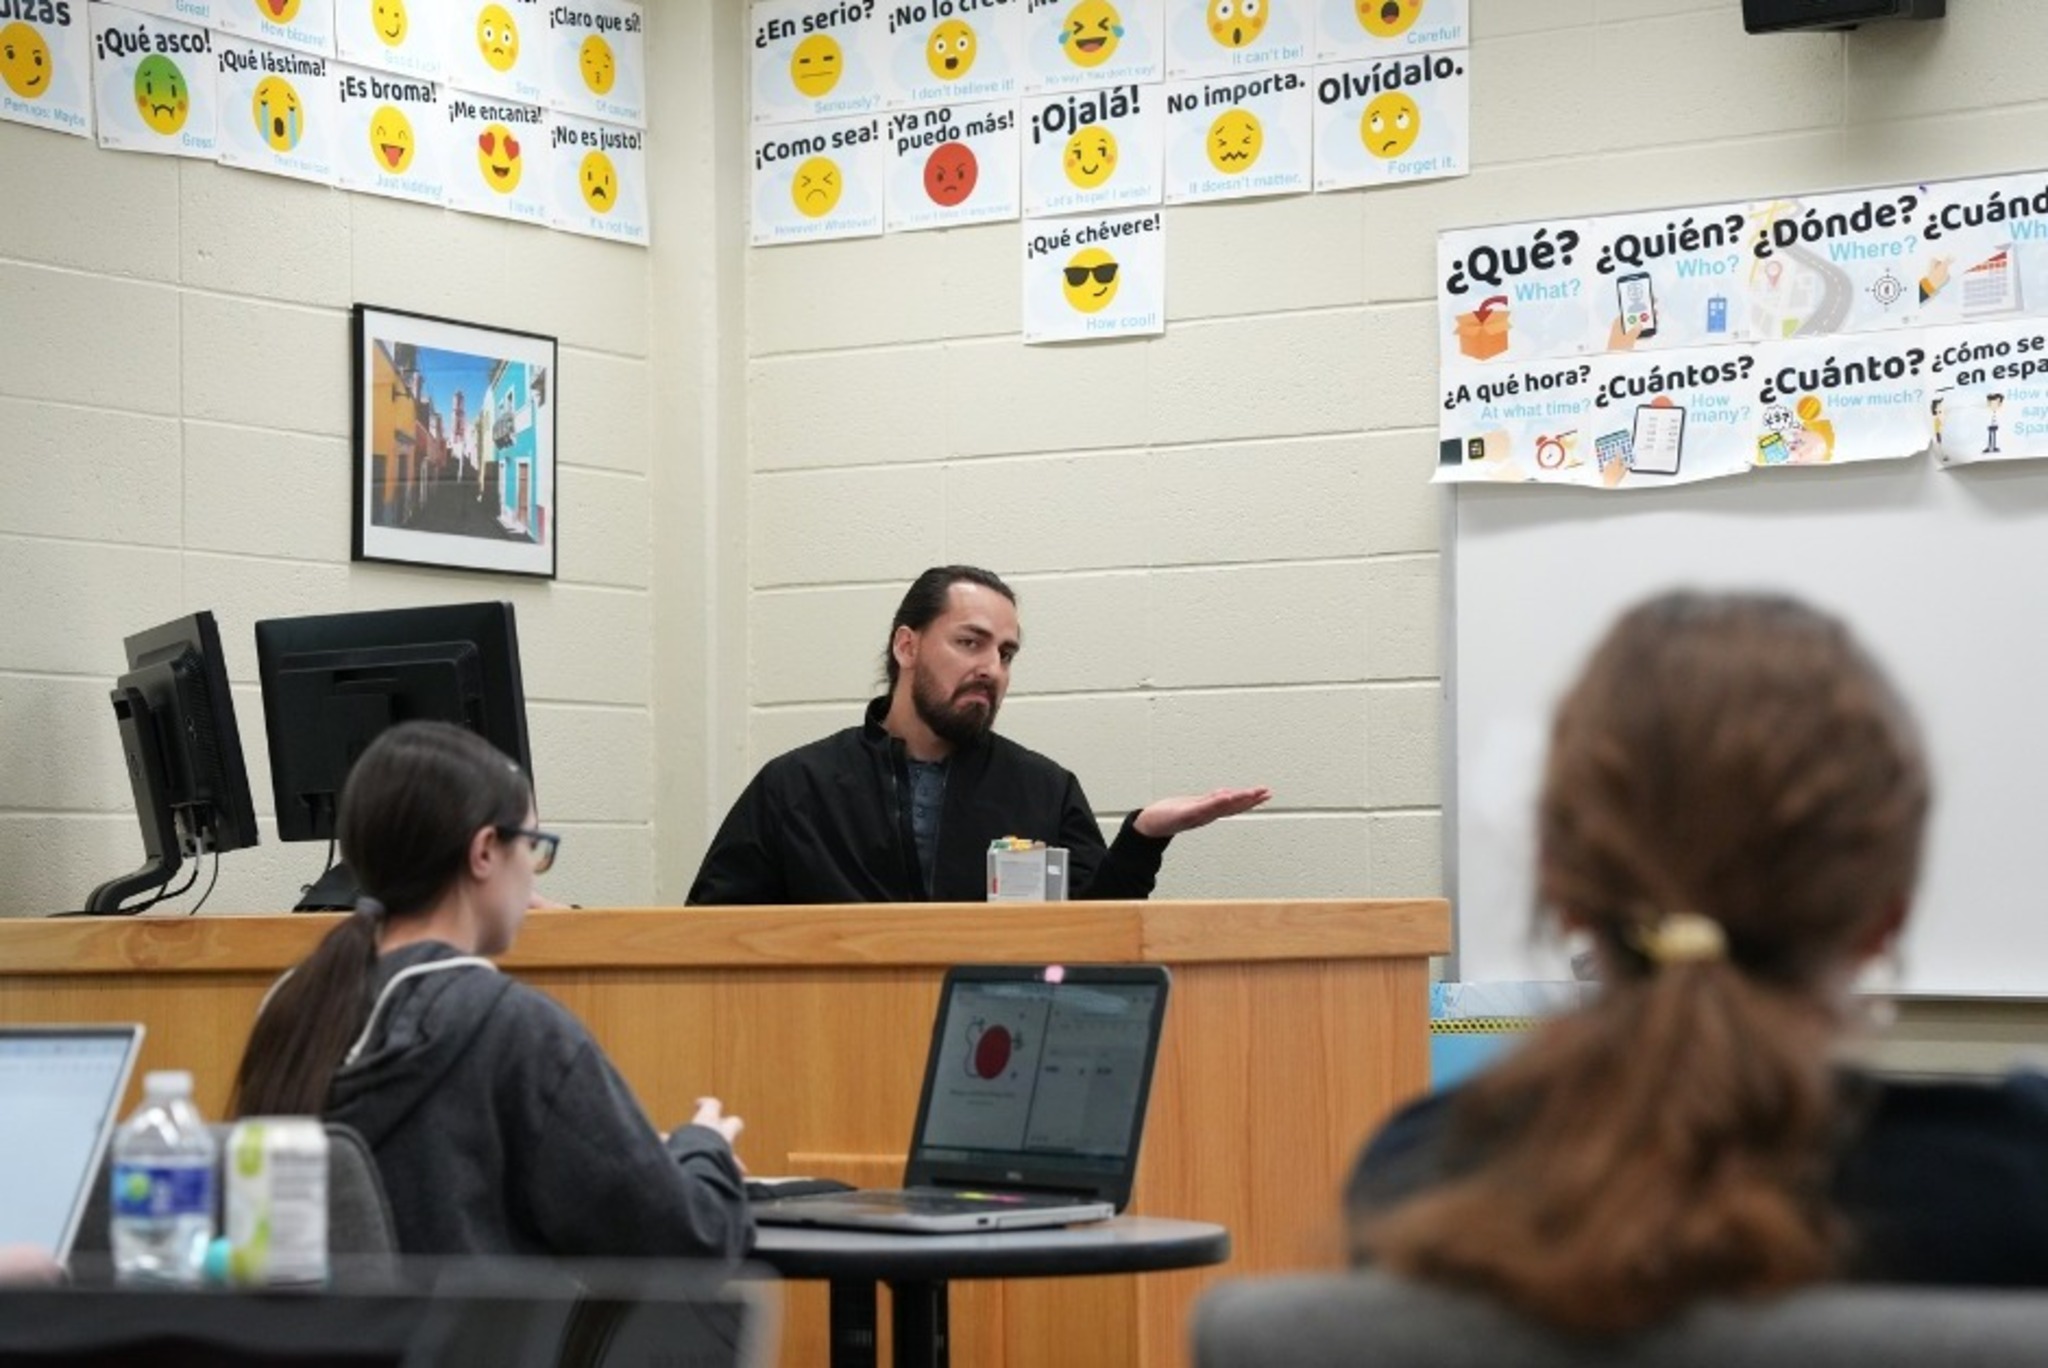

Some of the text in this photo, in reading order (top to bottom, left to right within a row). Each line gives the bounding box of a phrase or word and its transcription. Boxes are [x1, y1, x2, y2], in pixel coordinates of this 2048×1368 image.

[550, 5, 593, 29] ¡Claro
[595, 14, 622, 33] que
[755, 0, 875, 48] ¿En serio?
[888, 5, 926, 34] ¡No
[932, 0, 953, 18] lo
[96, 24, 212, 60] ¡Qué asco!
[1407, 27, 1461, 45] Careful!
[218, 49, 326, 77] ¡Qué lástima!
[340, 76, 437, 103] ¡Es broma!
[918, 84, 951, 99] don't
[953, 81, 999, 96] believe
[1167, 72, 1305, 114] No importa.
[1318, 54, 1463, 104] Olvídalo.
[449, 101, 543, 124] ¡Me encanta!
[814, 95, 881, 114] Seriously?
[1032, 84, 1140, 144] ¡Ojalá!
[551, 126, 641, 150] ¡No es justo!
[887, 108, 952, 140] ¡Ya no
[897, 110, 1015, 156] puedo más!
[755, 120, 879, 170] ¡Como sea!
[1387, 155, 1457, 177] Forget it.
[1028, 213, 1160, 259] ¡Qué chévere!
[1754, 195, 1918, 259] ¿Dónde?
[1596, 214, 1745, 275] ¿Quién?
[1829, 235, 1918, 262] Where?
[1446, 228, 1580, 295] ¿Qué?
[1676, 255, 1740, 279] Who?
[1515, 278, 1581, 302] What?
[1087, 313, 1156, 331] How cool!
[1931, 335, 2045, 373] ¿Cómo se
[1444, 365, 1591, 410] ¿A qué hora?
[1594, 355, 1755, 408] ¿Cuántos?
[1759, 348, 1925, 404] ¿Cuánto?
[1956, 368, 1986, 386] en
[1691, 393, 1730, 409] How
[1827, 388, 1924, 408] How much?
[2008, 388, 2041, 401] How
[1481, 398, 1592, 420] At what time?
[1691, 407, 1751, 426] many?
